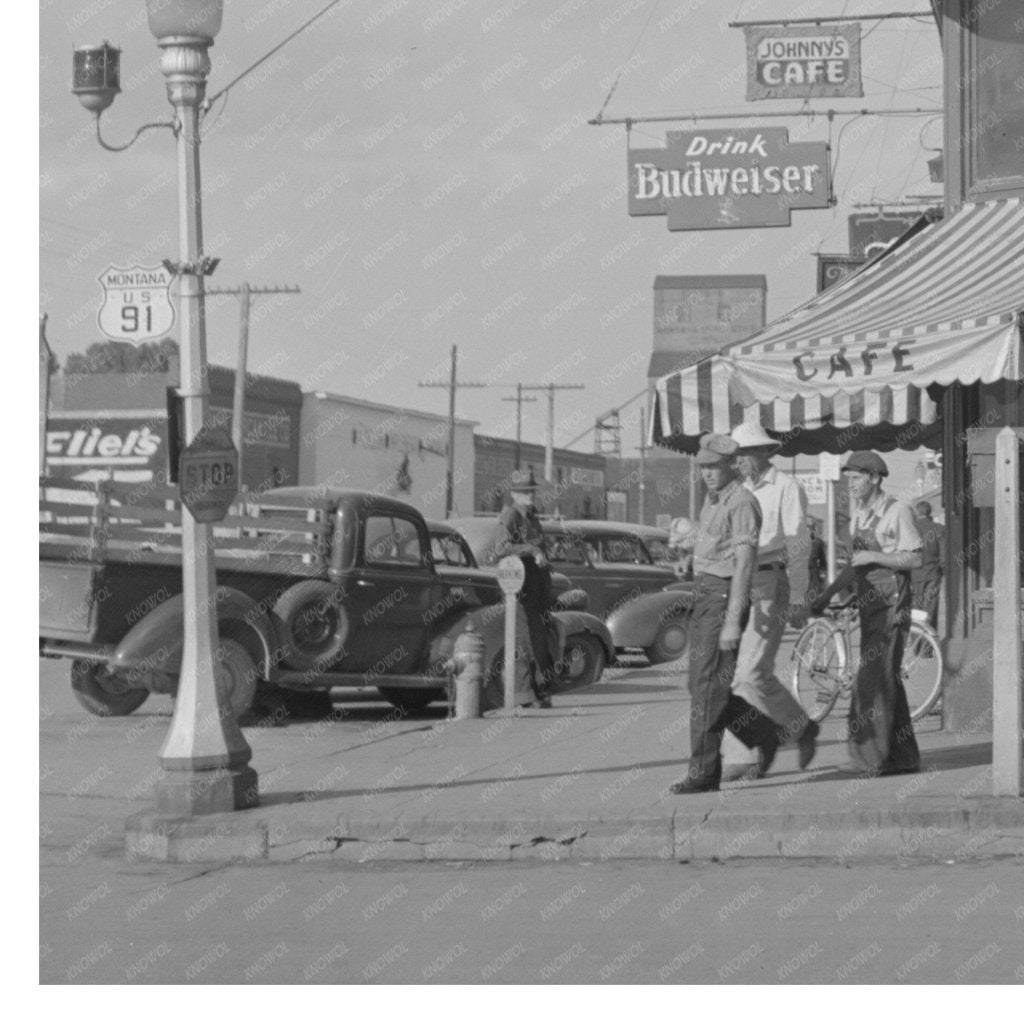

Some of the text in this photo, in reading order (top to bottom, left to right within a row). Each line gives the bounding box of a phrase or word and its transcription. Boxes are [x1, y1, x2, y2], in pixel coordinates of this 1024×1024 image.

[762, 60, 846, 85] CAFE
[685, 134, 768, 158] Drink
[634, 159, 820, 200] Budweiser
[107, 273, 167, 286] MONTANA
[121, 305, 152, 333] 91
[793, 339, 917, 382] CAFE
[186, 462, 234, 487] STOP
